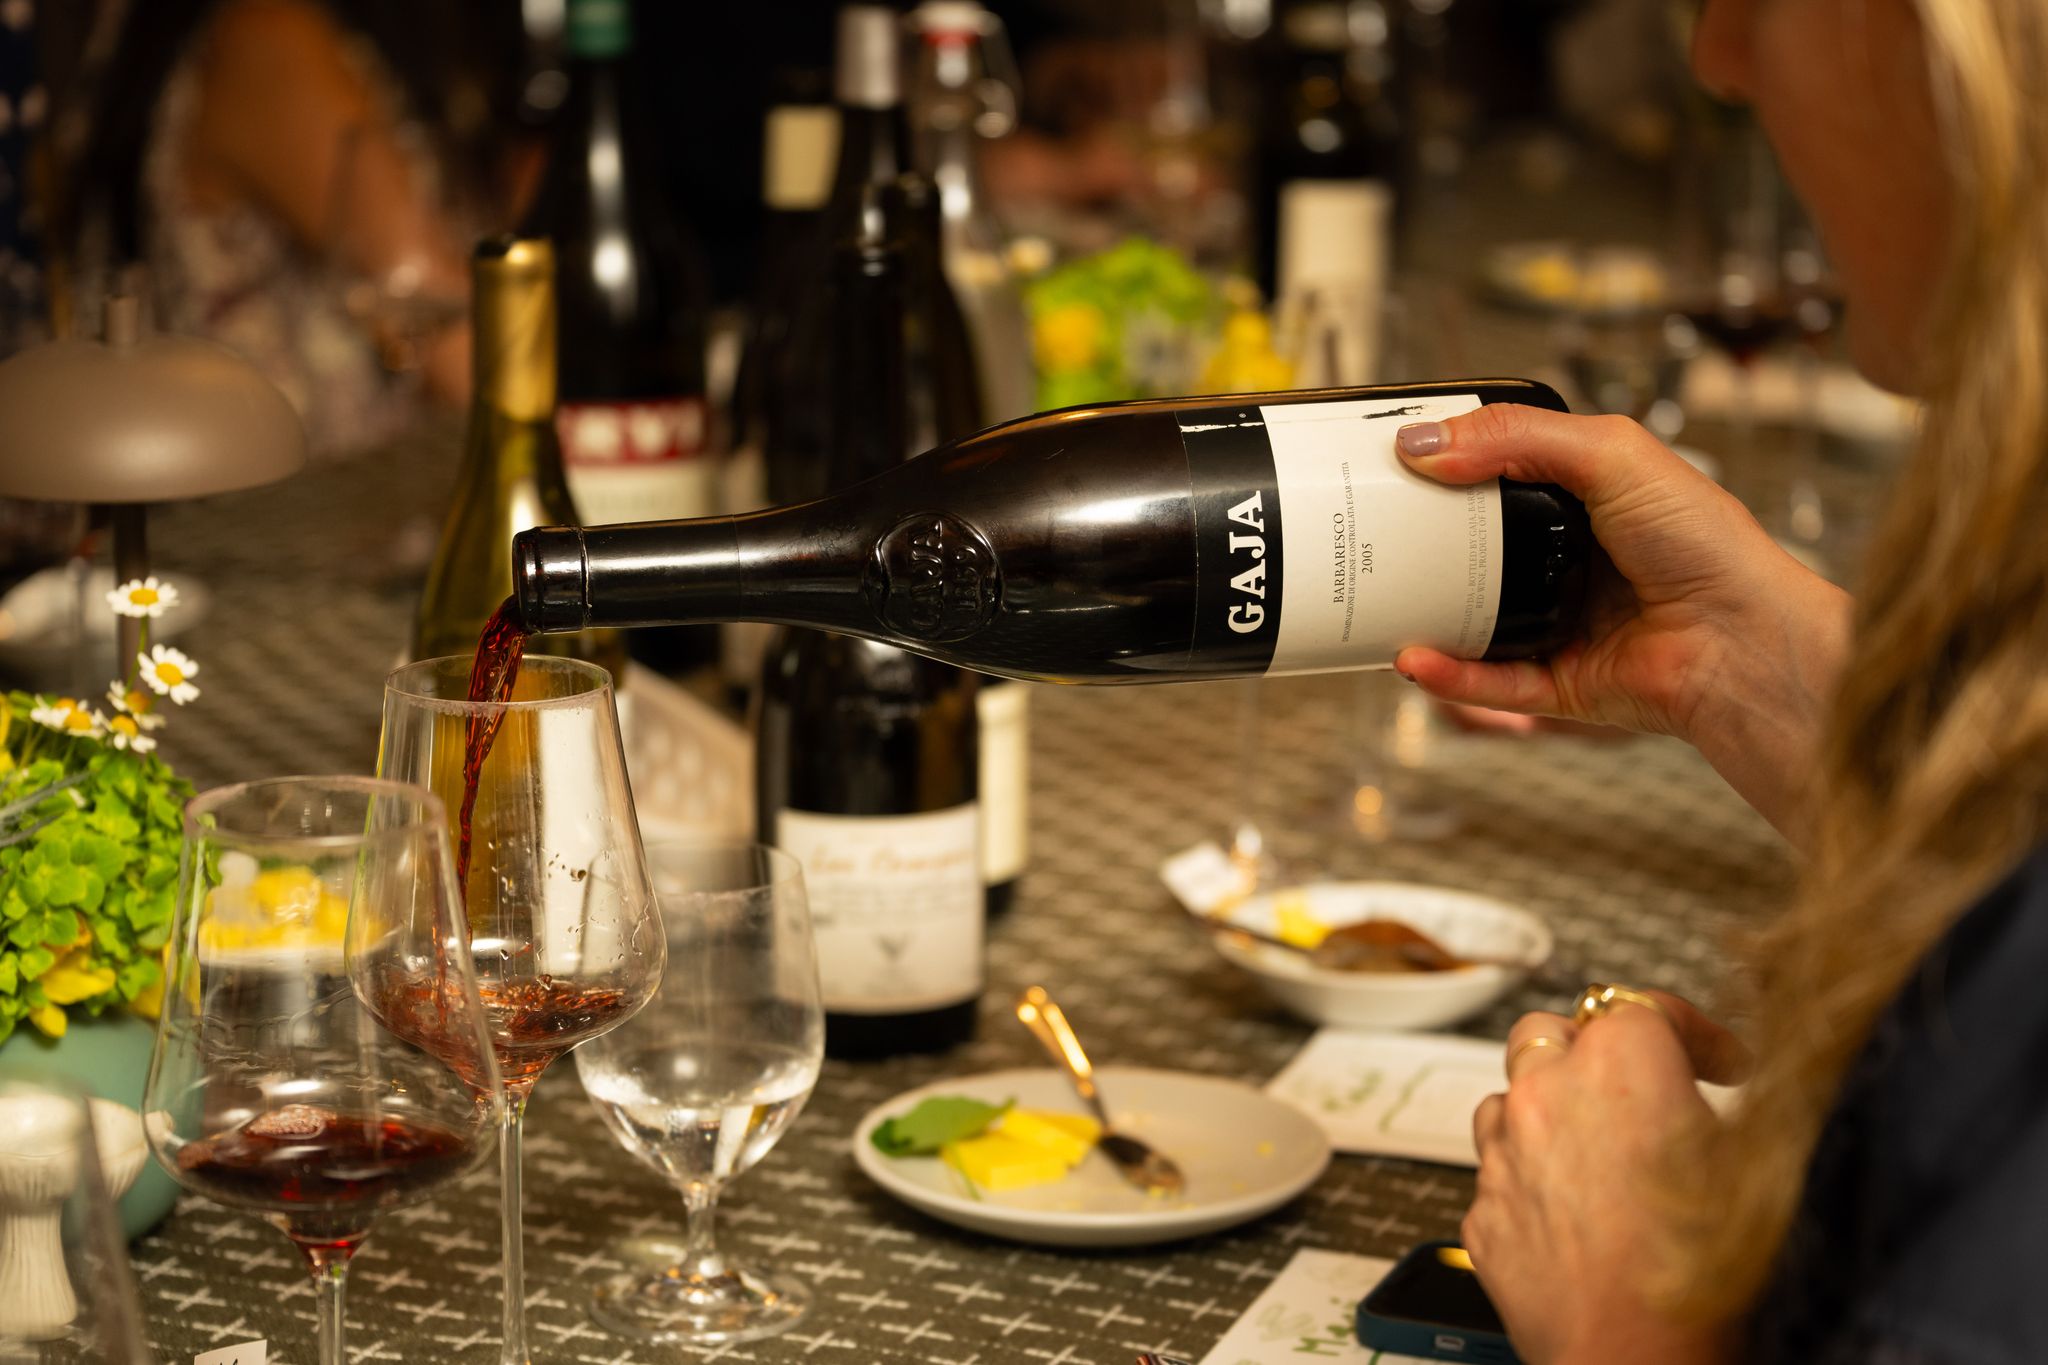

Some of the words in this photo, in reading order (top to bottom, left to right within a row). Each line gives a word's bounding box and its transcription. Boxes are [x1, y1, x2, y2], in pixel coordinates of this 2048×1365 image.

[1341, 461, 1353, 499] GARANTITA
[1346, 506, 1357, 557] CONTROLLATA
[1468, 514, 1478, 537] GAJA,
[1478, 516, 1487, 526] OF
[1333, 512, 1346, 603] BARBARESCO
[1361, 543, 1373, 574] 2005
[1468, 539, 1478, 549] BY
[1478, 530, 1488, 568] PRODUCT
[1227, 490, 1266, 634] GAJA
[1348, 558, 1357, 586] ORIGINE
[1468, 551, 1478, 587] BOTTLED
[1476, 570, 1488, 593] WINE,
[1475, 594, 1485, 608] RED
